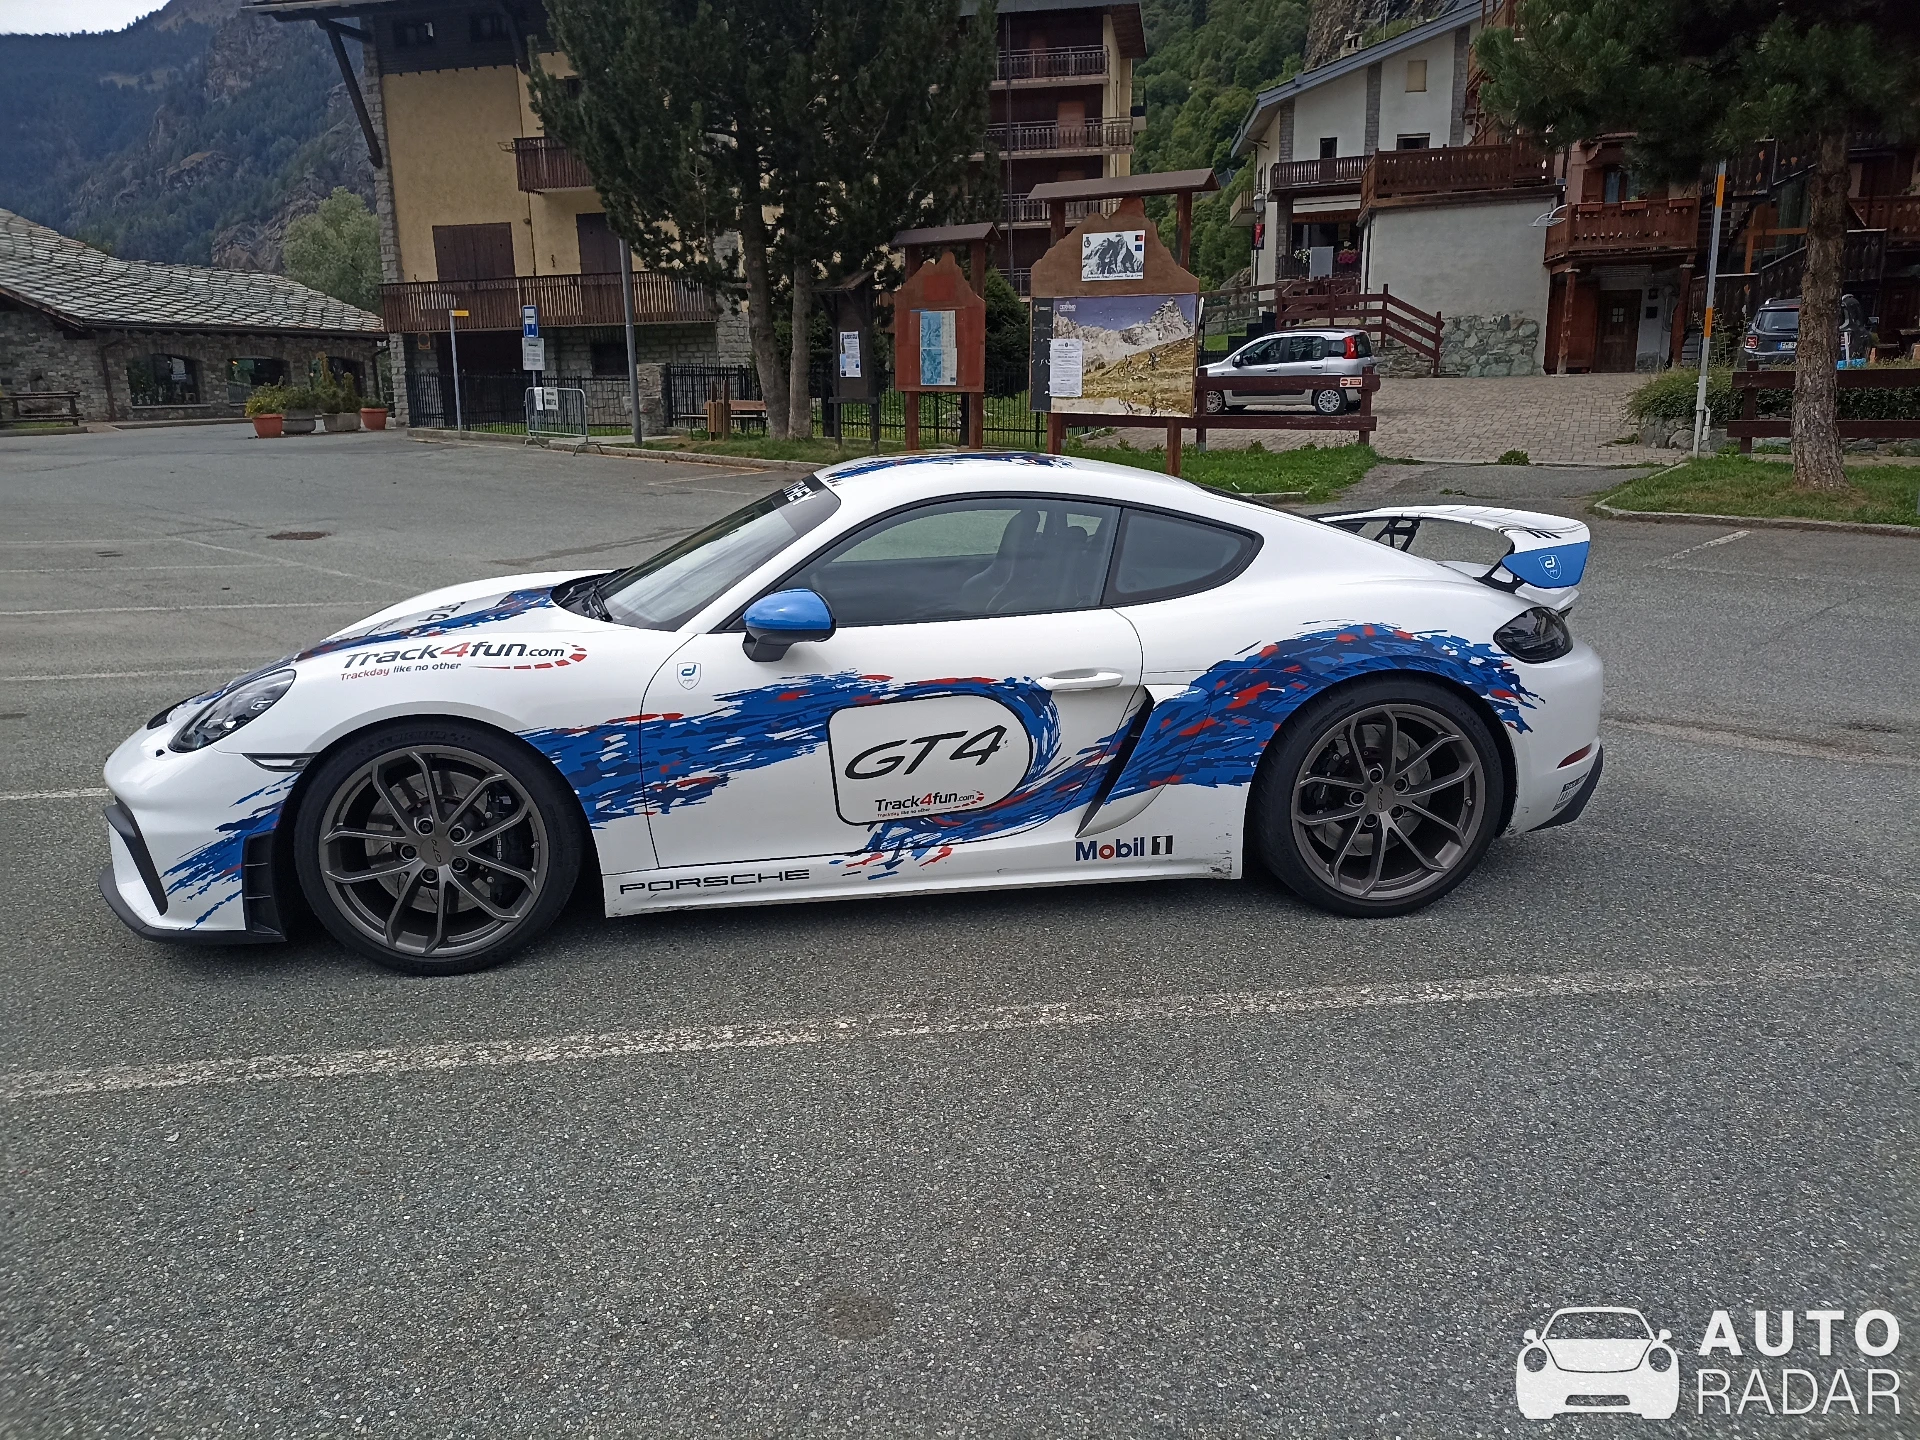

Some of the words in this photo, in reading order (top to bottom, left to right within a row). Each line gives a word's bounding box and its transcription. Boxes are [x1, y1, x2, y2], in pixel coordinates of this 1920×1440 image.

[343, 641, 565, 669] Track4fun.com
[340, 668, 390, 681] Trackday
[393, 665, 412, 674] like
[415, 663, 428, 671] no
[432, 662, 461, 670] other
[845, 724, 1007, 780] GT4
[875, 792, 975, 811] Track4fun.com
[1075, 837, 1145, 861] Mobil
[1153, 835, 1169, 856] 1
[619, 869, 810, 895] PORSCHE
